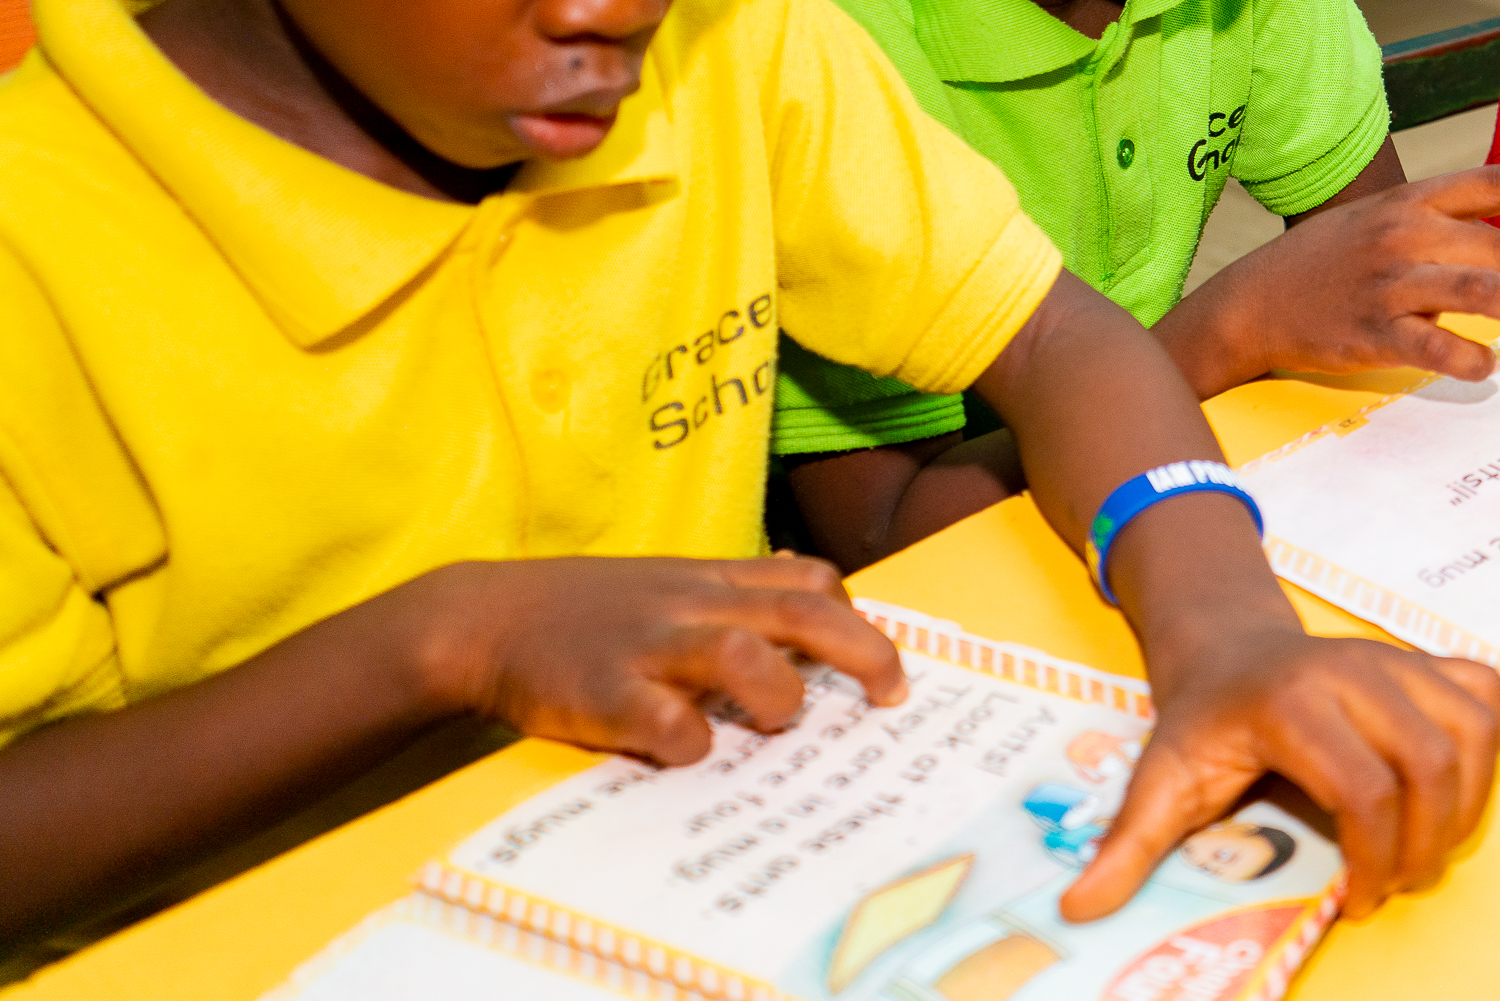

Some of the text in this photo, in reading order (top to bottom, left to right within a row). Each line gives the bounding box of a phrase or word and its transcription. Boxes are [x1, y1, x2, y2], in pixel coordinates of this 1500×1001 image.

[1417, 549, 1490, 588] mug
[881, 684, 974, 745] They
[934, 691, 1021, 750] Look
[974, 705, 1058, 777] Ants!
[759, 744, 822, 788] are
[825, 744, 886, 788] are
[900, 753, 940, 786] at
[684, 790, 767, 840] four
[759, 816, 789, 835] a
[784, 793, 836, 818] in
[799, 792, 905, 852] these
[1113, 934, 1223, 1001] Fou
